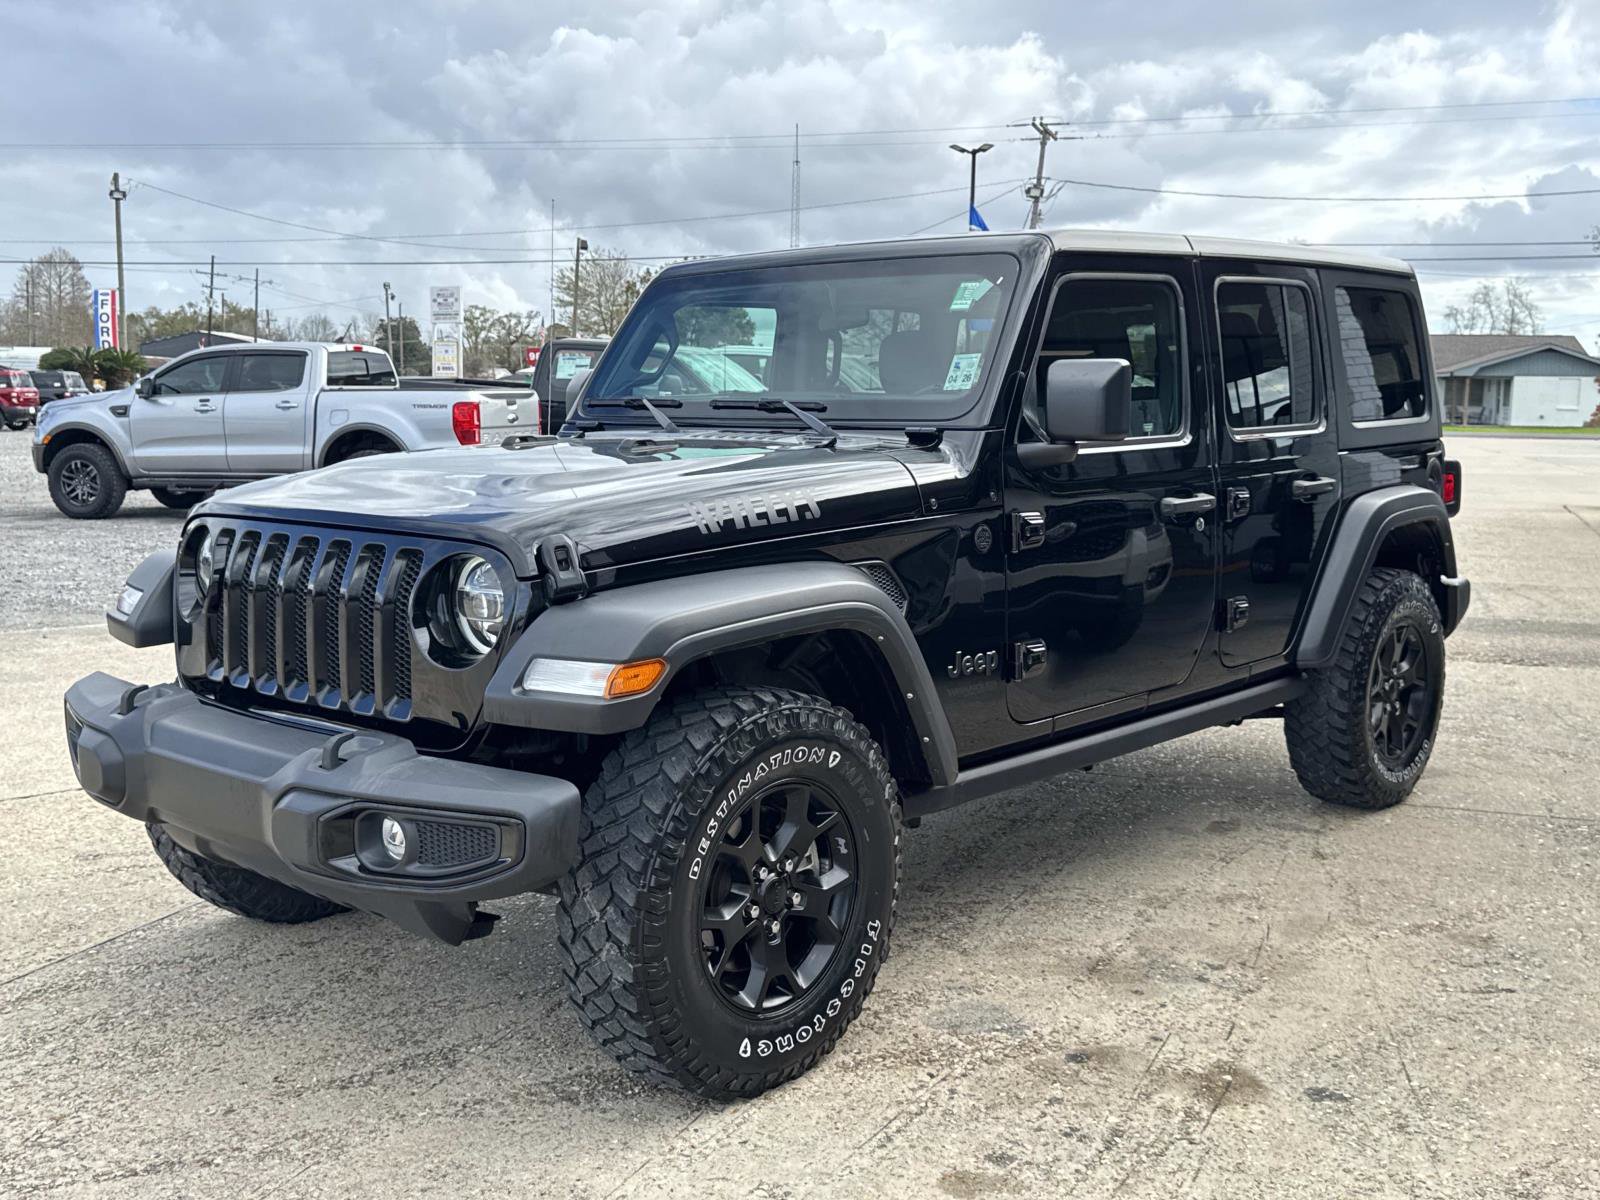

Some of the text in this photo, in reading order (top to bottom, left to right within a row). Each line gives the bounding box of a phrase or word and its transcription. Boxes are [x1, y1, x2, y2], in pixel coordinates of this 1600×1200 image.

[100, 299, 111, 351] FORD
[948, 373, 972, 384] 04 26
[948, 650, 998, 678] Jeep
[689, 746, 825, 880] DESTINATION
